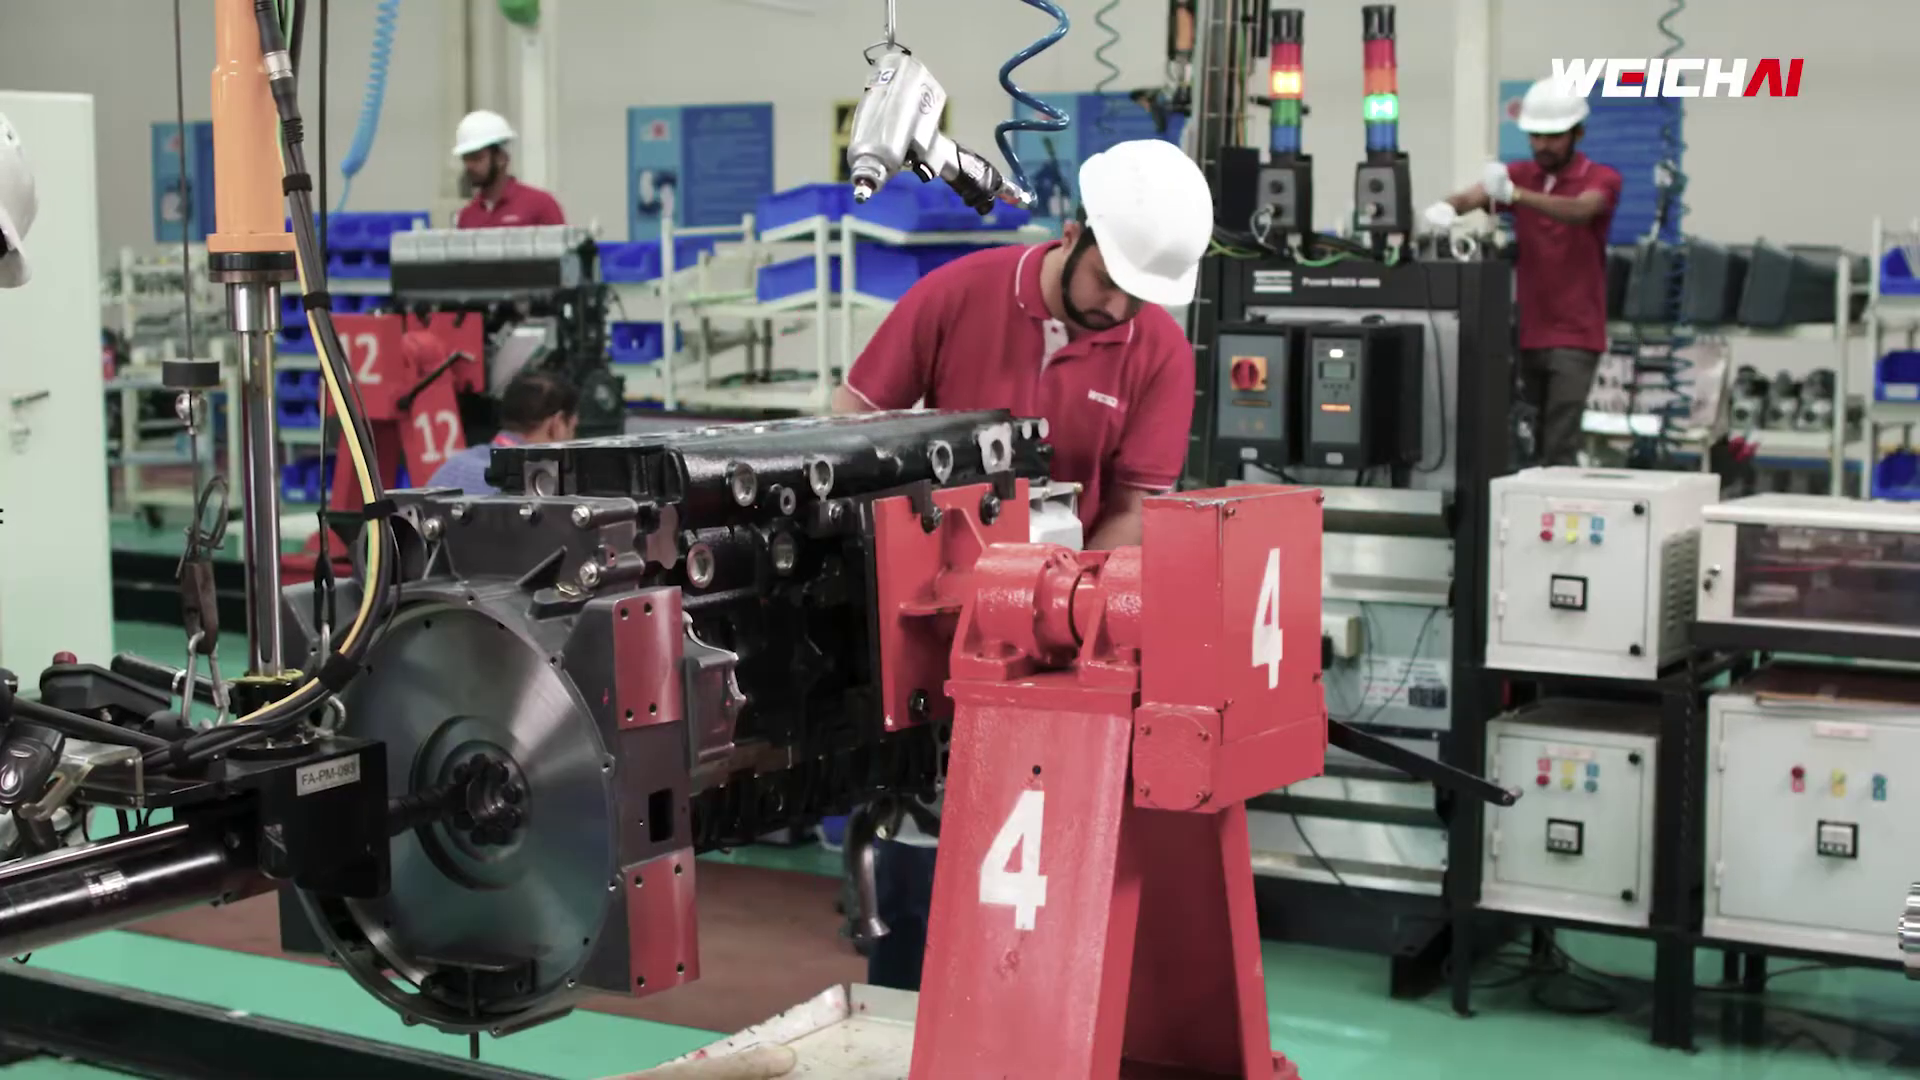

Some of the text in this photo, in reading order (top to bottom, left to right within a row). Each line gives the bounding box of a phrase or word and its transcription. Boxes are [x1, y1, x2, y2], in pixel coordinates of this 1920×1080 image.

[414, 410, 459, 463] 12
[1252, 547, 1284, 690] 4
[980, 790, 1048, 930] 4
